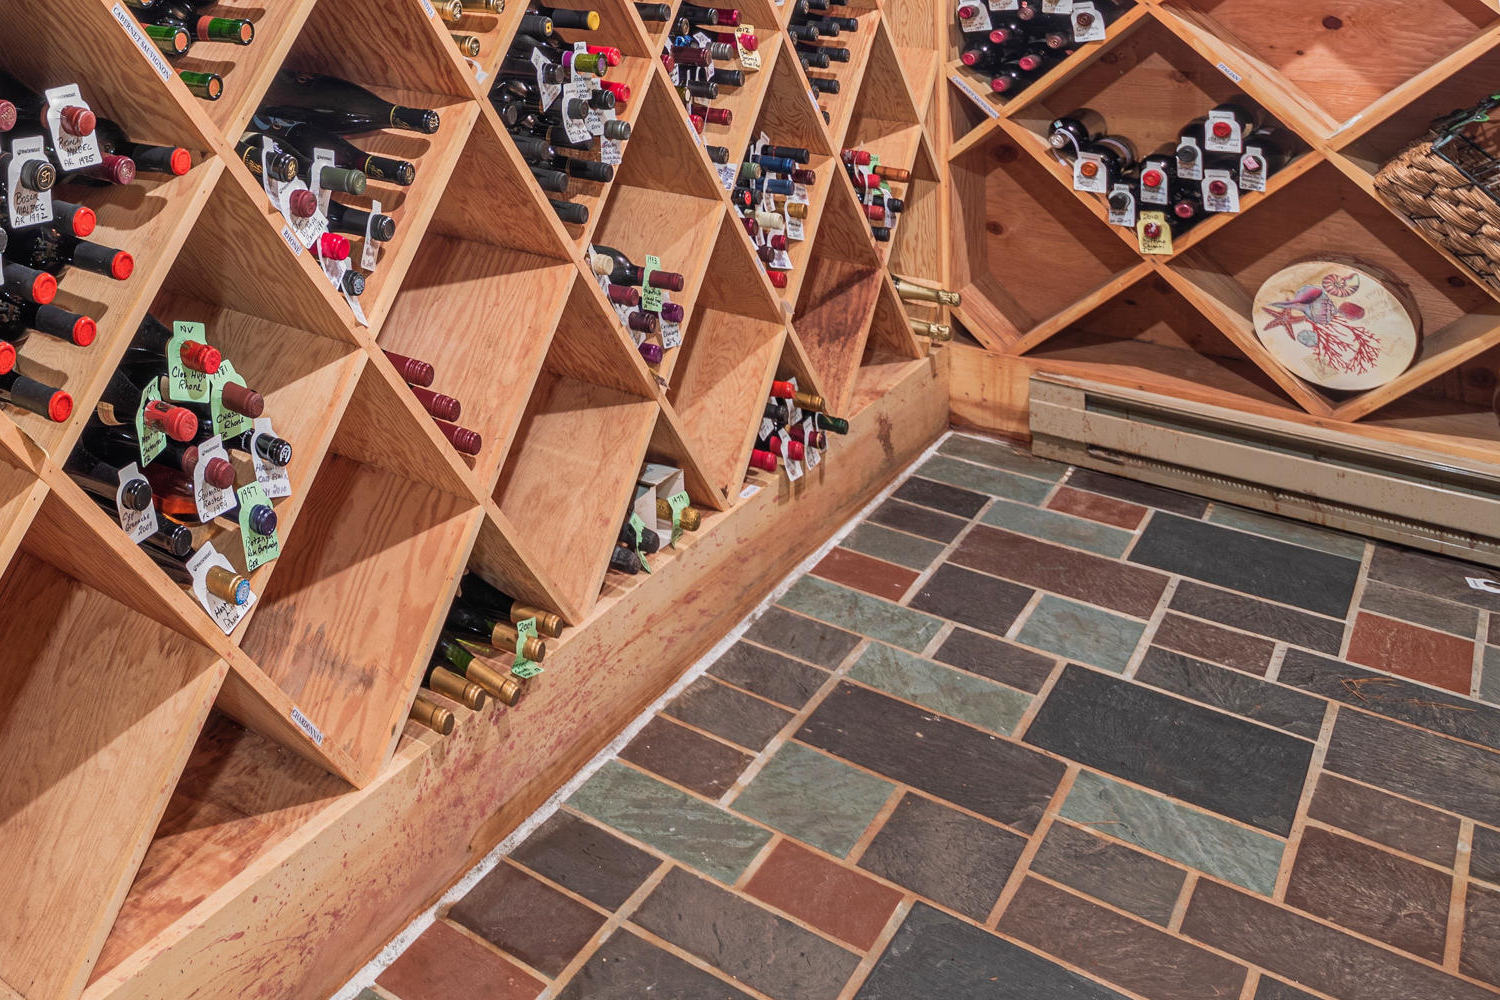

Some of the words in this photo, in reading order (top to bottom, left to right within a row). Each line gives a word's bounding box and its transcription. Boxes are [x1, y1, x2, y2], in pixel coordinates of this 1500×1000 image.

[112, 6, 140, 45] CABERNET
[136, 39, 171, 80] SAUVIGNON
[282, 229, 302, 254] RHONE
[291, 708, 323, 745] CHARDONNAY
